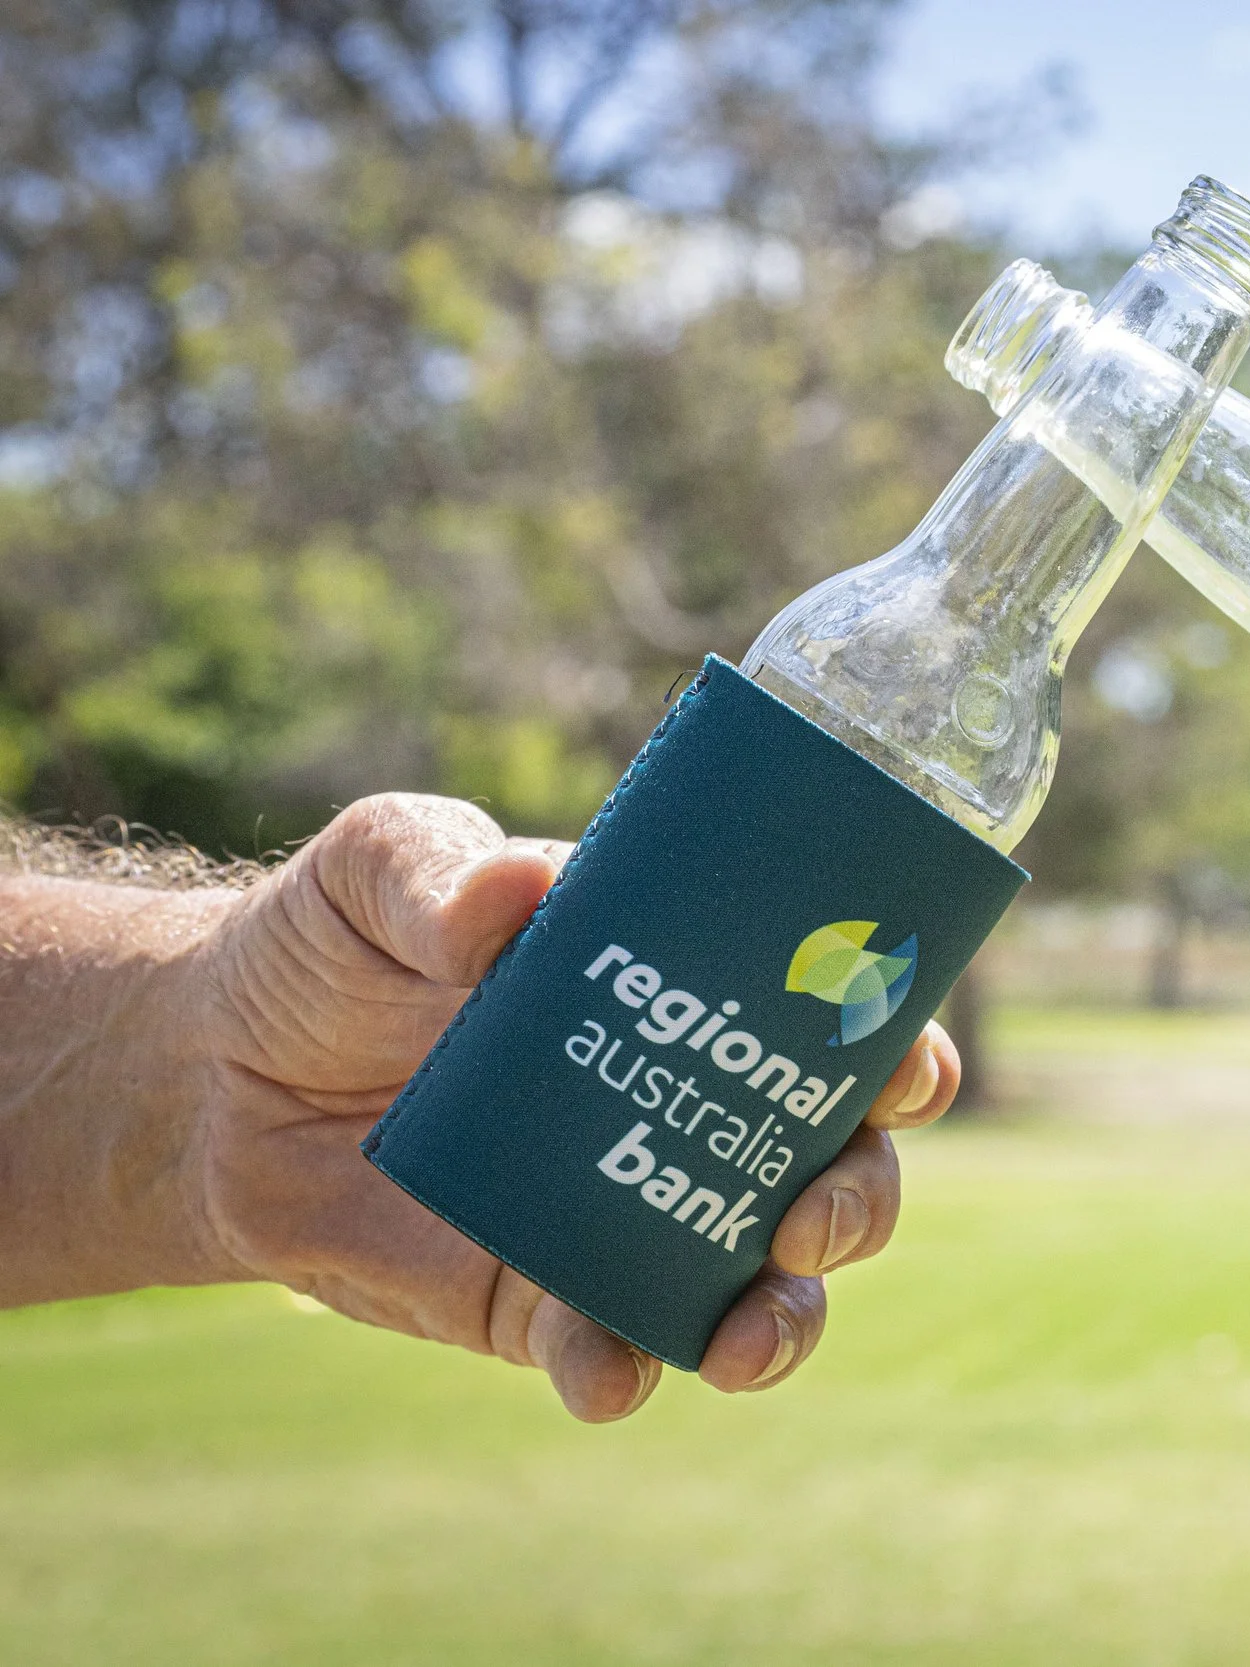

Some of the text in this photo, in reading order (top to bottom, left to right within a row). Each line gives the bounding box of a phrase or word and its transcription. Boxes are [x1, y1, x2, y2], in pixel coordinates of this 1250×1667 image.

[565, 1020, 793, 1188] australia
[584, 943, 857, 1127] regional
[597, 1121, 760, 1252] bank
